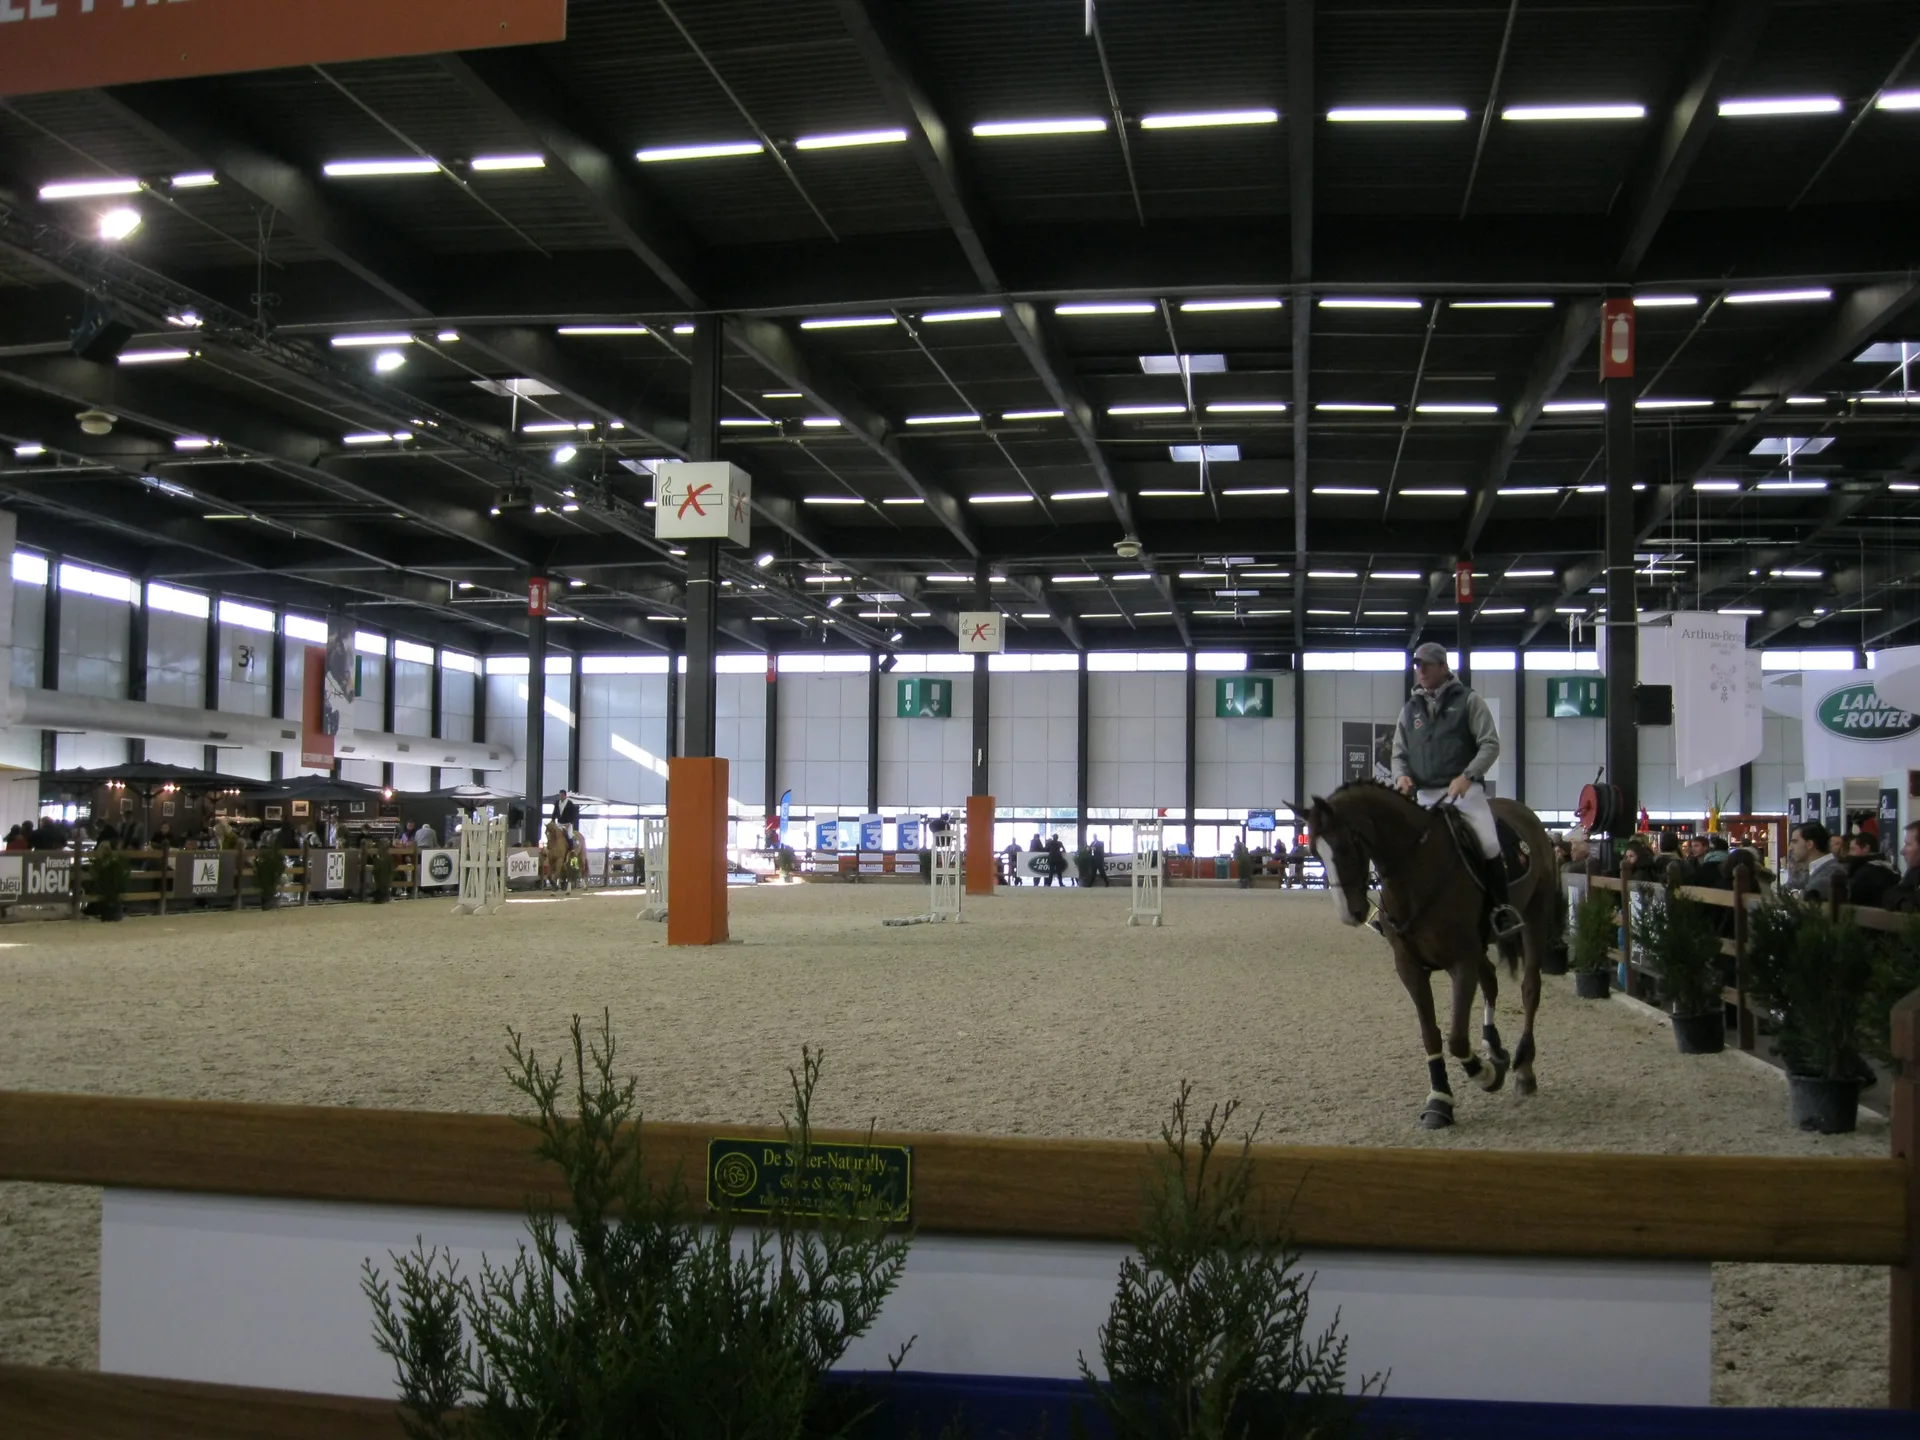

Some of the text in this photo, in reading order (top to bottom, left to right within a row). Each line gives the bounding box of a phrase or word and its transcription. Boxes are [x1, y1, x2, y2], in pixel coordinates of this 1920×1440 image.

[1844, 711, 1912, 728] ROVER
[821, 829, 838, 850] 3
[866, 829, 882, 850] 3
[903, 829, 920, 850] 3
[511, 860, 531, 872] SPORT
[28, 862, 70, 893] bleu
[763, 1148, 782, 1166] De
[811, 1176, 822, 1189] &
